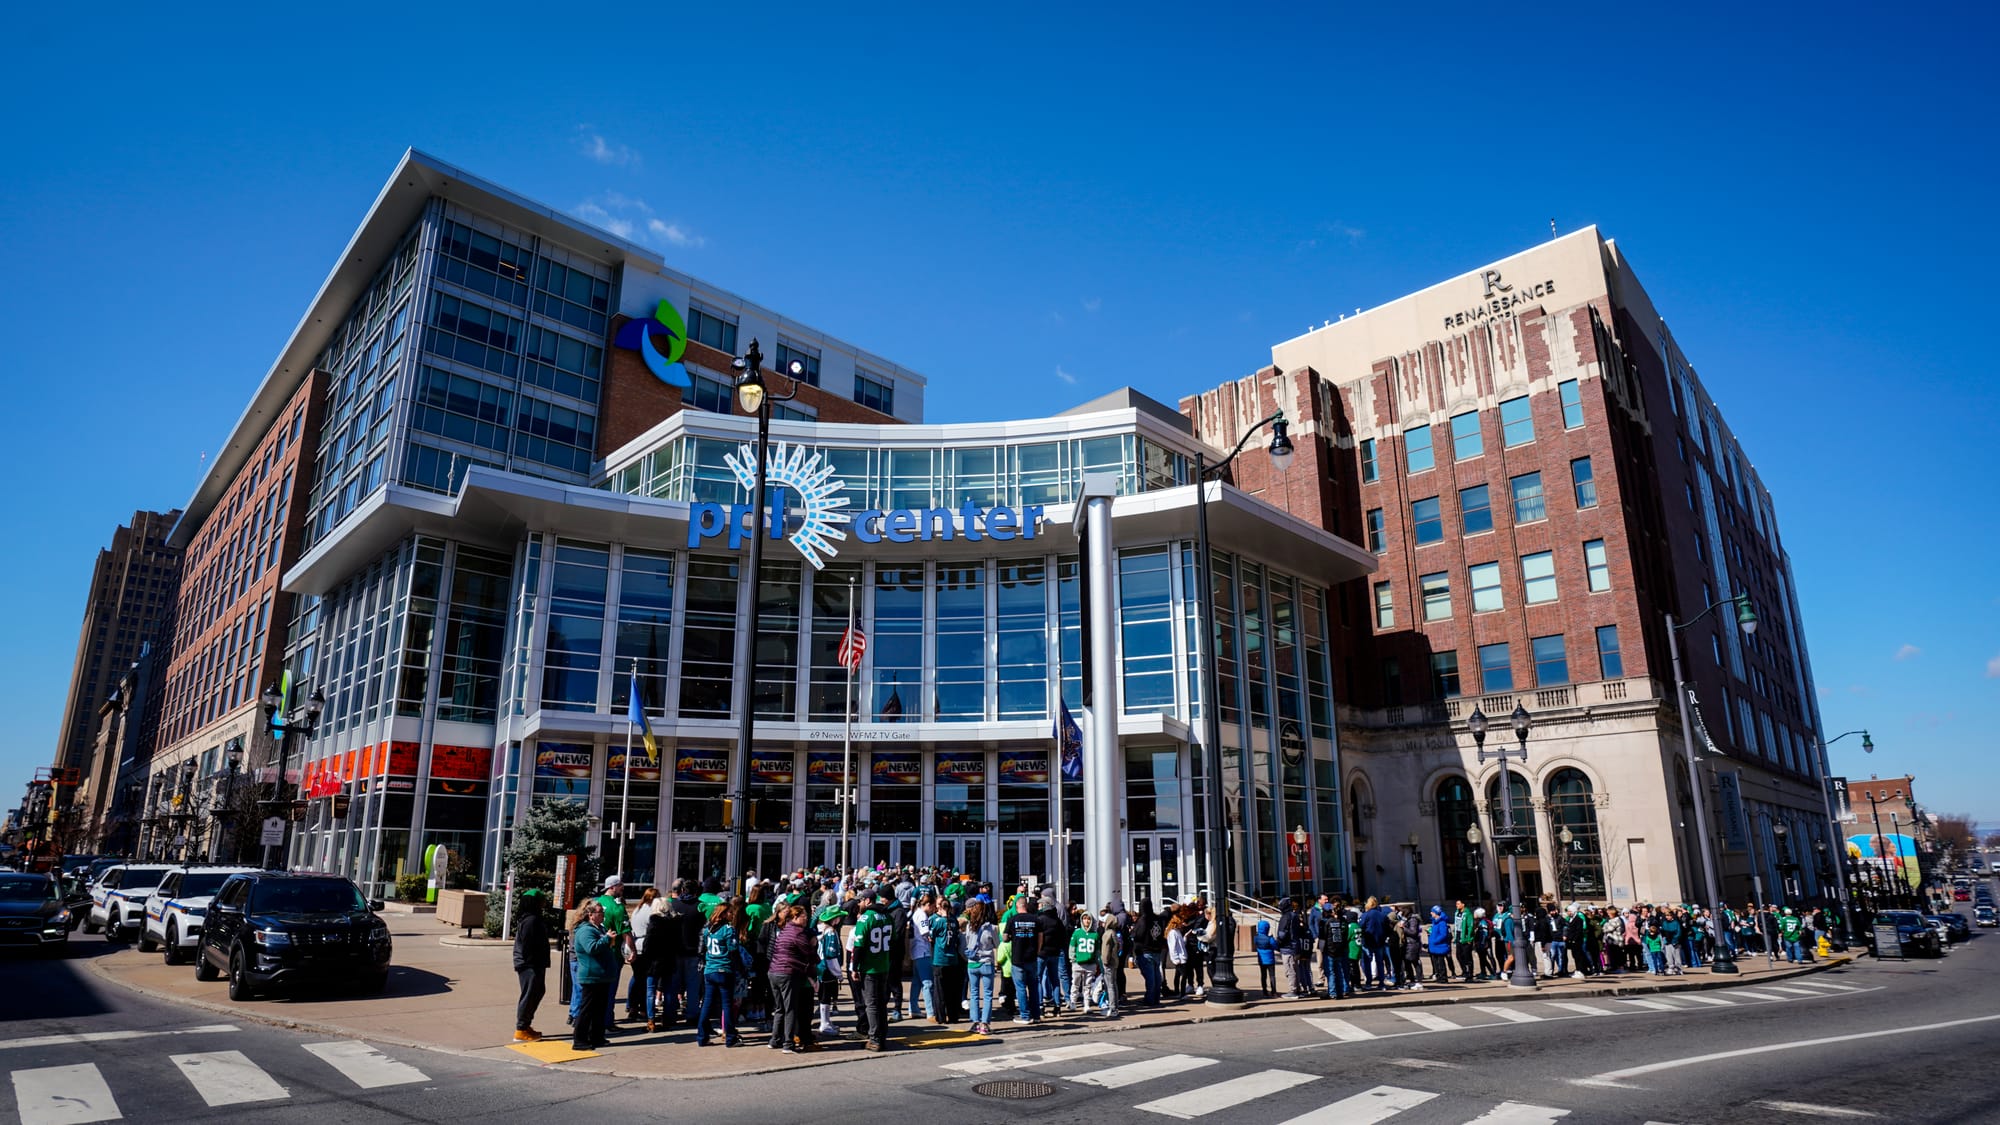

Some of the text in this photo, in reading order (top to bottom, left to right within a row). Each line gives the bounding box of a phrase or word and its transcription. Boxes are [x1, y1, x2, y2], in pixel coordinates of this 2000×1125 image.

[1480, 269, 1513, 299] R
[1444, 280, 1555, 330] RENAISSANCE
[687, 487, 1044, 550] ppl center
[810, 731, 820, 739] 69
[822, 731, 844, 739] News
[891, 731, 911, 739] Gate
[537, 751, 589, 765] 69 NEWS
[608, 754, 625, 767] 69
[677, 756, 726, 770] 69 NEWS
[1000, 758, 1046, 772] 69 NEWS
[760, 761, 792, 771] NEWS
[809, 760, 825, 773] 69
[873, 760, 919, 773] 69 NEWS
[937, 759, 983, 773] 69 NEWS
[1833, 781, 1846, 790] R
[1573, 840, 1584, 850] R
[870, 925, 892, 953] 92
[1078, 938, 1095, 953] 26
